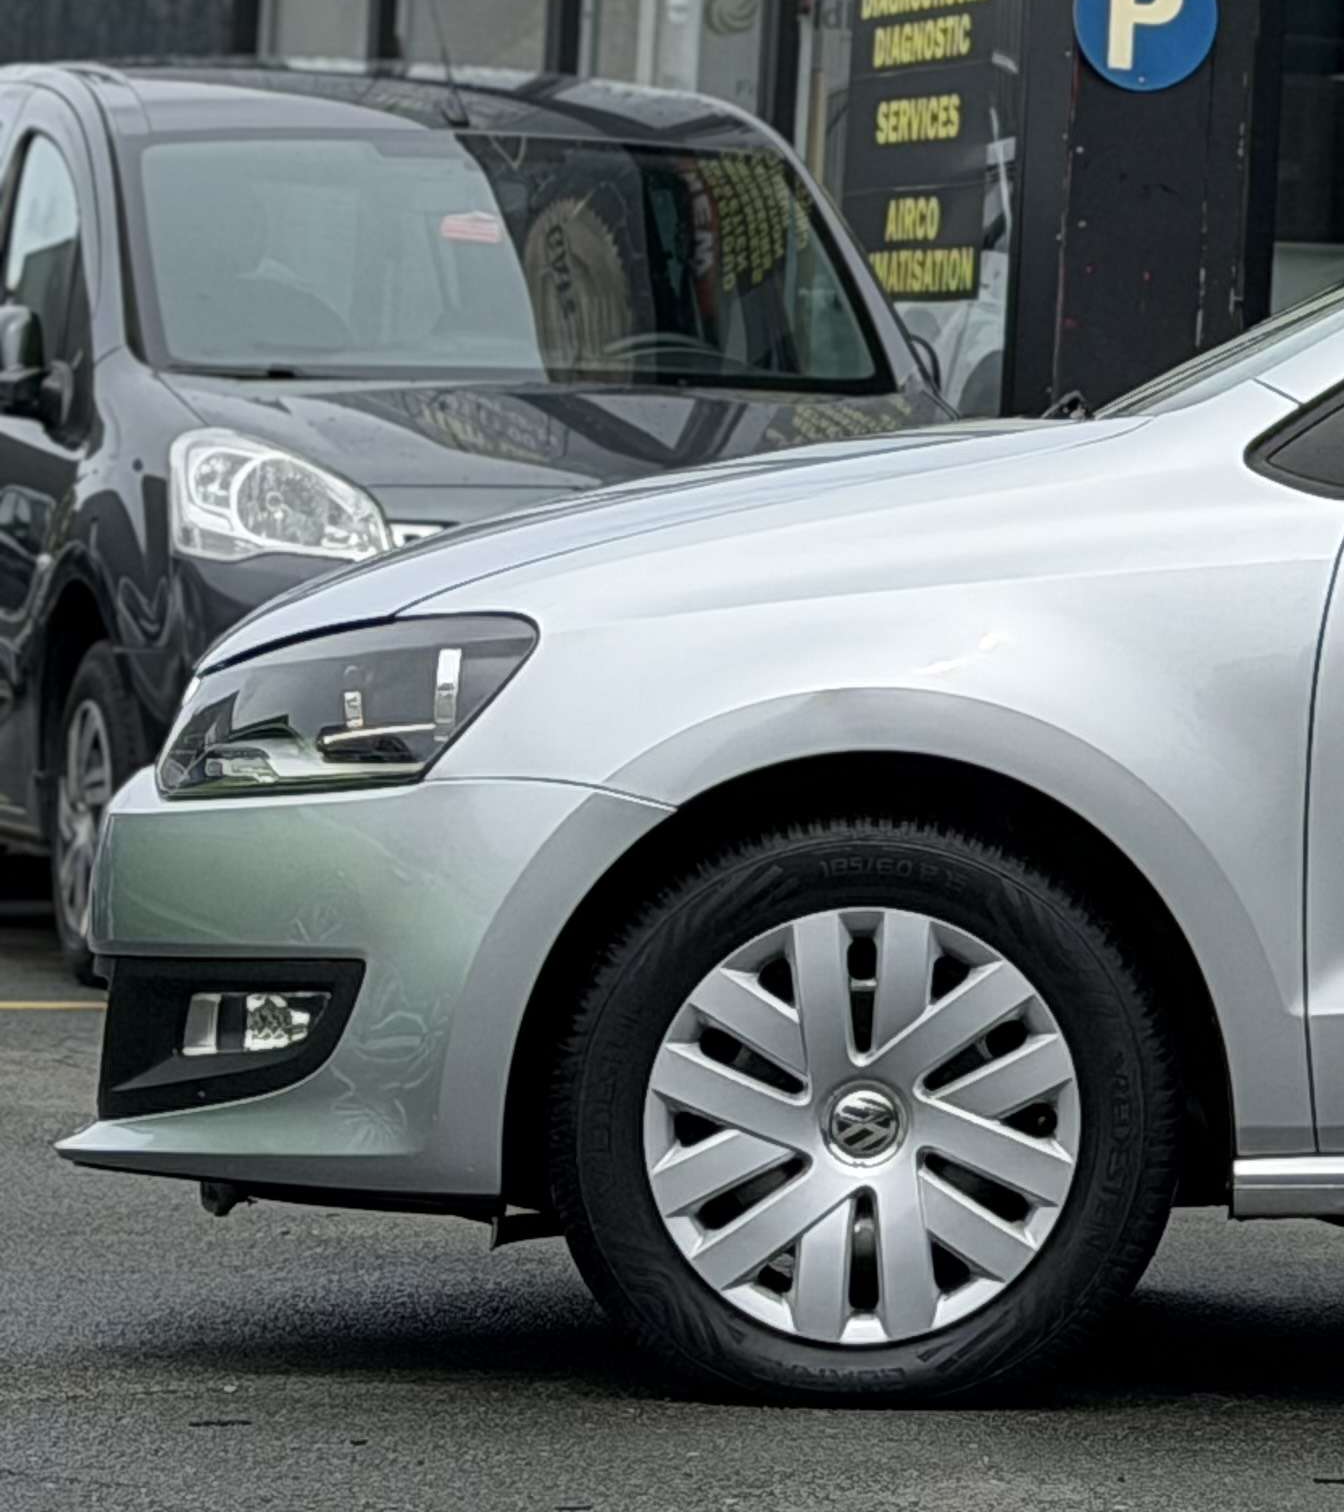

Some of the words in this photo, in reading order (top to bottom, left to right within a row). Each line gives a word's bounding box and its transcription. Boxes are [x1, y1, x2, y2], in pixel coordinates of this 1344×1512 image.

[873, 14, 972, 68] DIAGNOSTIC
[876, 94, 961, 144] SERVICES
[885, 196, 940, 242] AIRCO
[869, 246, 974, 293] MATISATION
